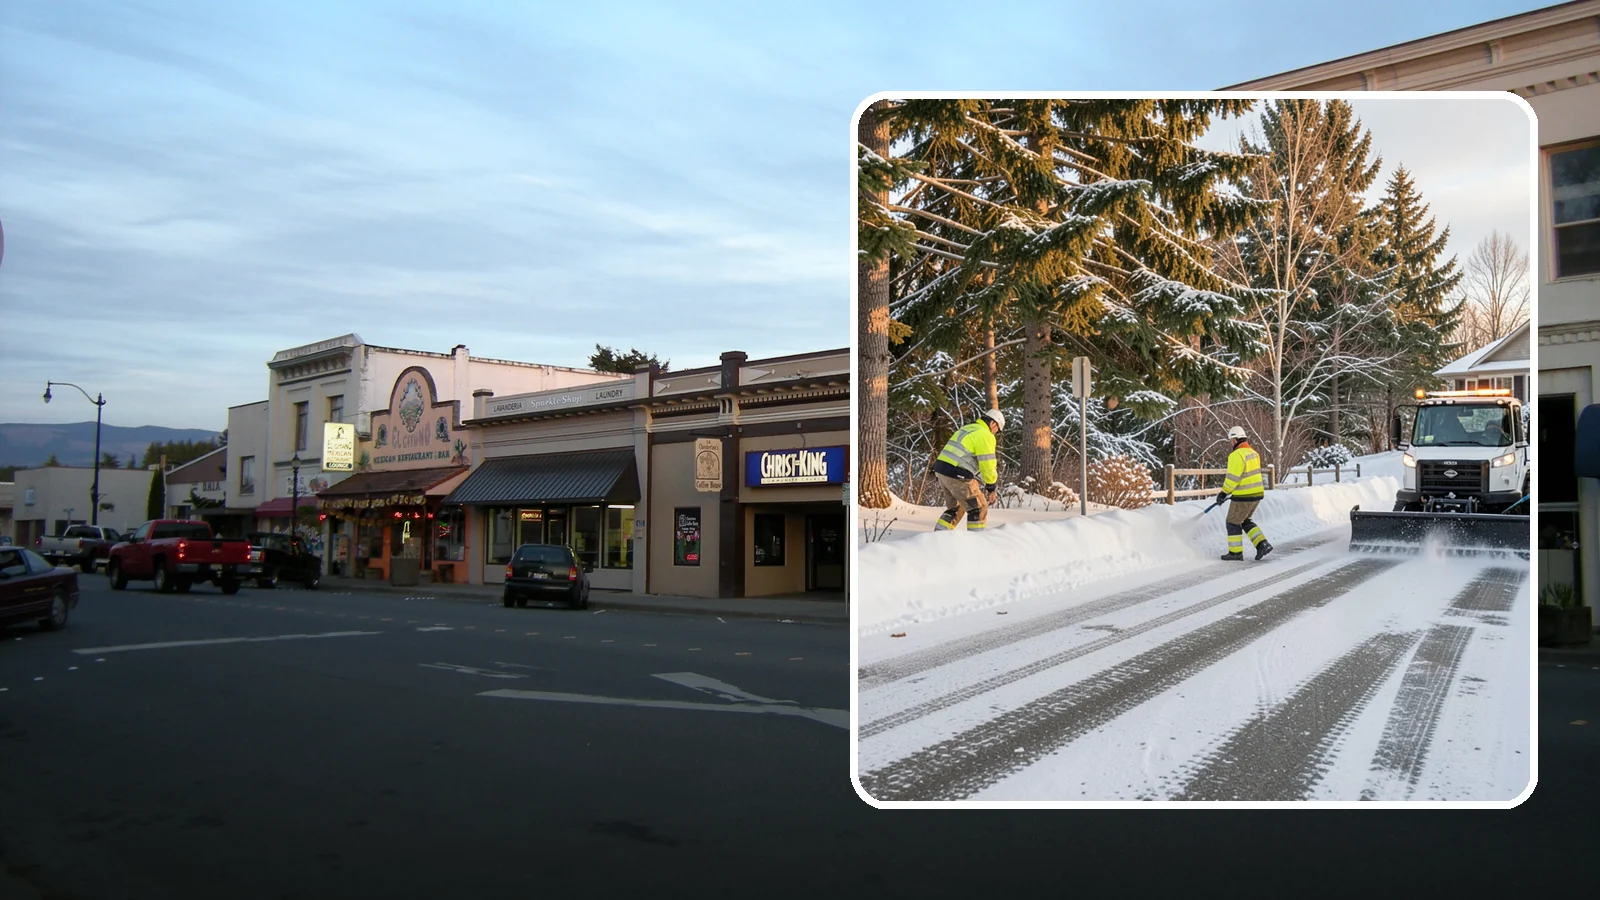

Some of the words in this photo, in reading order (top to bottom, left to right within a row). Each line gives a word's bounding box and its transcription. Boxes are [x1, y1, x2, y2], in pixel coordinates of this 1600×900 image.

[562, 394, 583, 405] Shop
[595, 389, 623, 400] LAUNDRY
[493, 402, 522, 412] LAVANDERIA
[373, 455, 396, 464] MEXICAN
[397, 451, 434, 462] RESTAURANT
[438, 450, 450, 459] BAR
[761, 452, 797, 478] CHRIST
[799, 450, 827, 476] KING
[696, 480, 709, 489] Coffee
[710, 480, 721, 489] House
